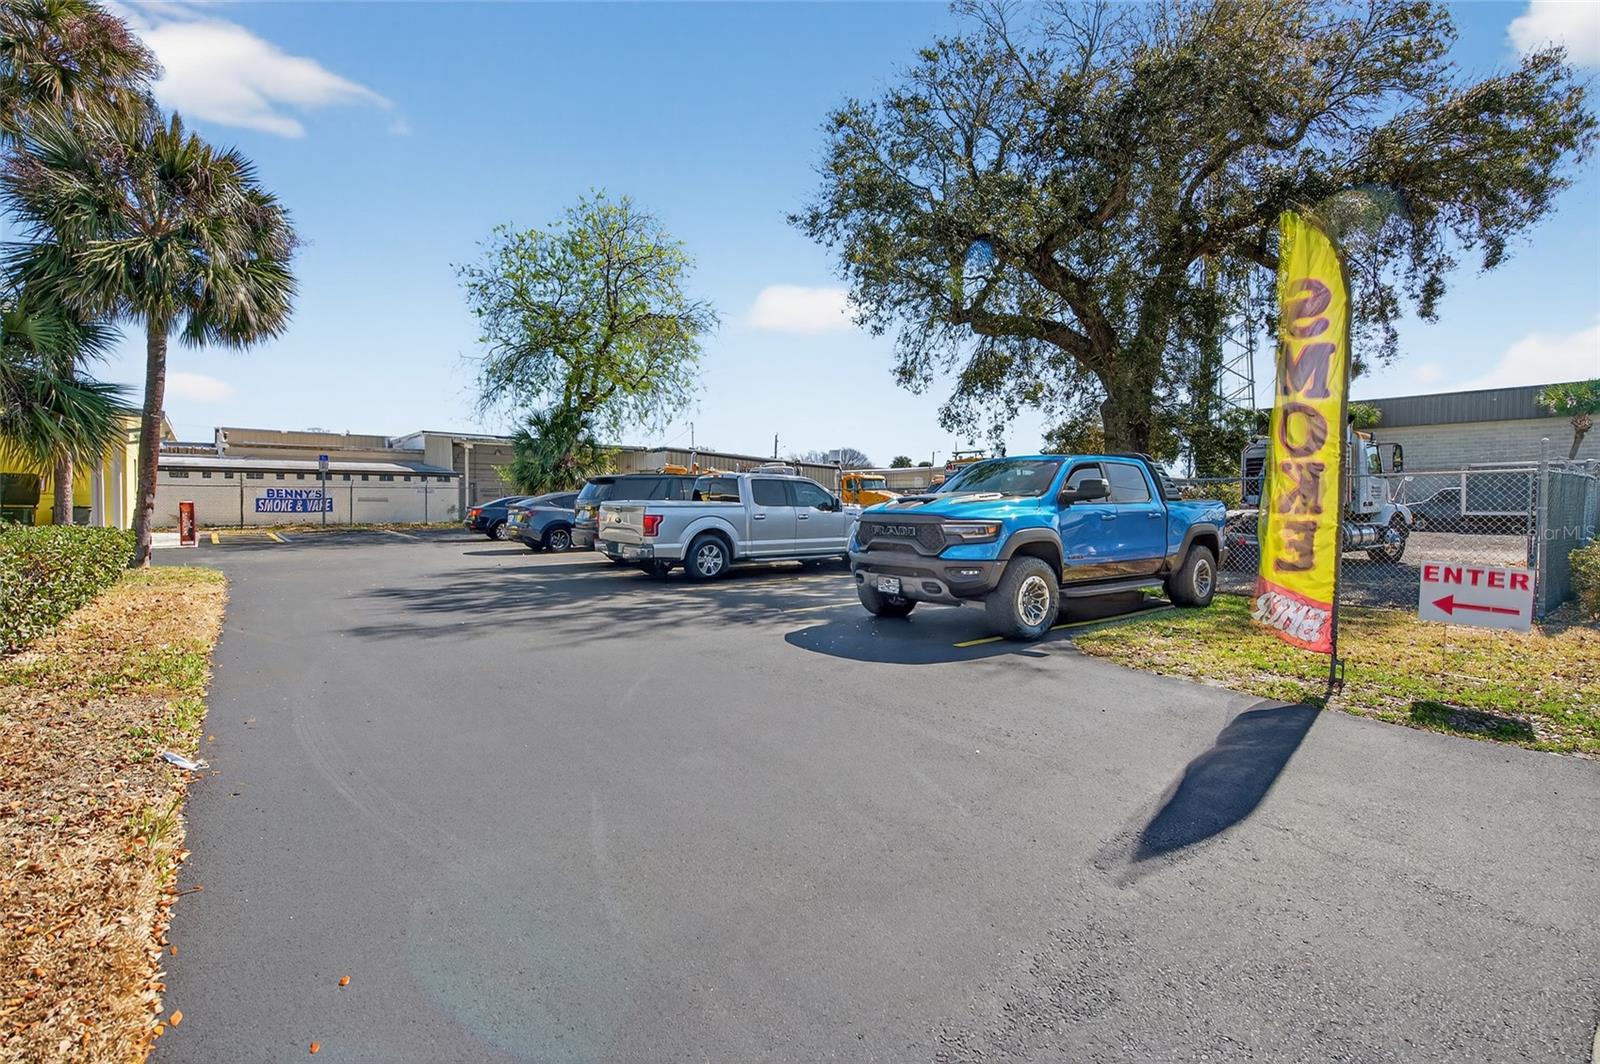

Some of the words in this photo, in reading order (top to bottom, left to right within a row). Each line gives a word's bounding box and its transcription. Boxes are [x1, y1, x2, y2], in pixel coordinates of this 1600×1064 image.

[266, 488, 322, 498] BENNY'S
[258, 499, 293, 512] SMOKE
[296, 500, 303, 511] &
[1423, 565, 1530, 591] ENTER
